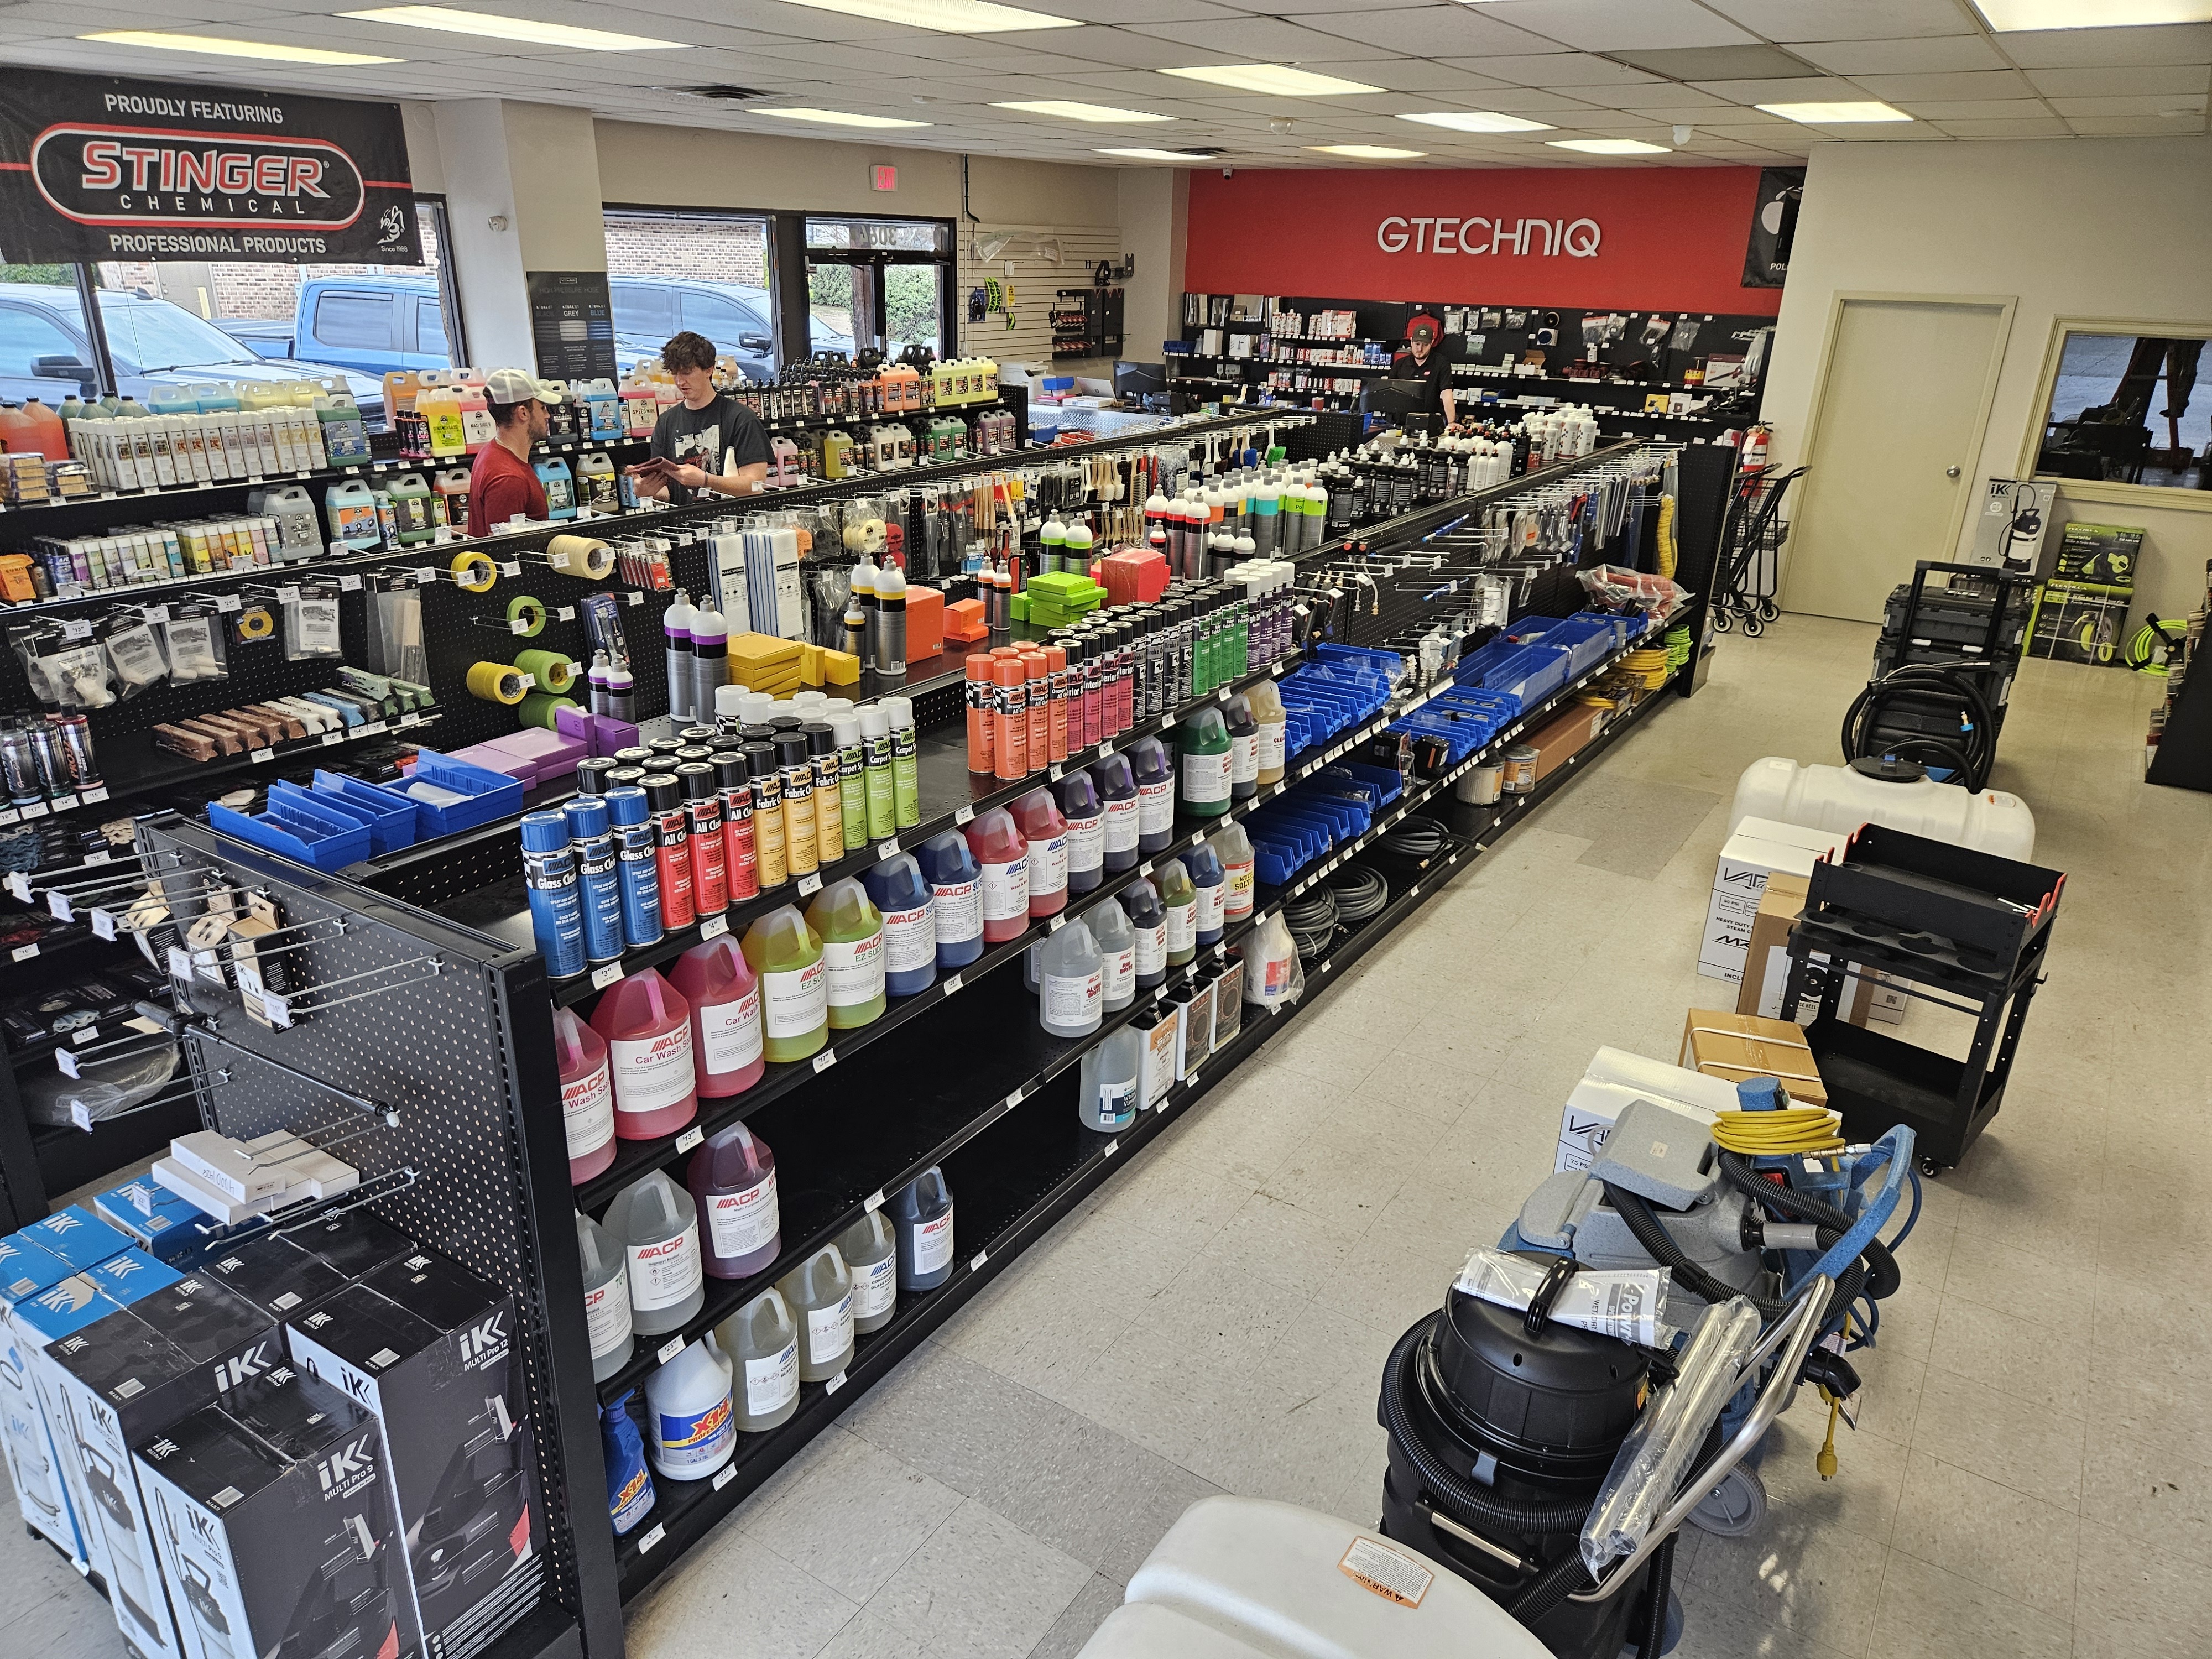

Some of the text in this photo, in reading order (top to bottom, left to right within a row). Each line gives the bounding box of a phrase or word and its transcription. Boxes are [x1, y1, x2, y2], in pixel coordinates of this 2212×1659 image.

[105, 94, 284, 124] PROUDLY FEATURING
[82, 140, 331, 199] STINGER
[878, 166, 895, 189] EXIT
[120, 195, 305, 215] CHEMICAL
[109, 234, 326, 253] PROFESSIONAL PRODUCTS
[1377, 217, 1601, 257] GTECHNIQ
[895, 745, 913, 755] Carpet
[870, 755, 888, 765] Carpet
[838, 764, 857, 774] Carpet
[816, 776, 834, 786] Fabric
[785, 789, 805, 798] Fabric
[1147, 784, 1167, 796] ACP
[757, 798, 777, 809] Fabric
[1115, 800, 1136, 812] ACP
[731, 810, 742, 821] All
[697, 820, 707, 833] All
[1076, 819, 1098, 831] ACP
[665, 833, 675, 846] All
[620, 849, 643, 862] Glass
[581, 863, 604, 875] Glass
[538, 878, 562, 890] Glass
[943, 884, 972, 897] ACP
[896, 909, 925, 924] ACP
[1716, 916, 1734, 925] HEAVY
[1726, 925, 1745, 933] STEAM
[863, 932, 883, 952] ACP
[855, 954, 867, 962] EZ
[801, 981, 812, 990] EZ
[726, 1004, 759, 1026] Car Wash
[661, 1025, 689, 1050] ACP
[635, 1045, 681, 1065] Car Wash
[575, 1072, 606, 1096] ACP
[568, 1092, 596, 1109] Wash
[727, 1189, 760, 1208] ACP
[648, 1237, 684, 1258] ACP
[666, 1253, 680, 1262] Alcohol
[870, 1281, 885, 1290] GLASS
[459, 1311, 507, 1362] iK
[464, 1339, 508, 1371] MULTI Pro 12
[215, 1341, 270, 1392] iK
[317, 1433, 373, 1491] iK
[324, 1464, 373, 1501] MULTI Pro 9
